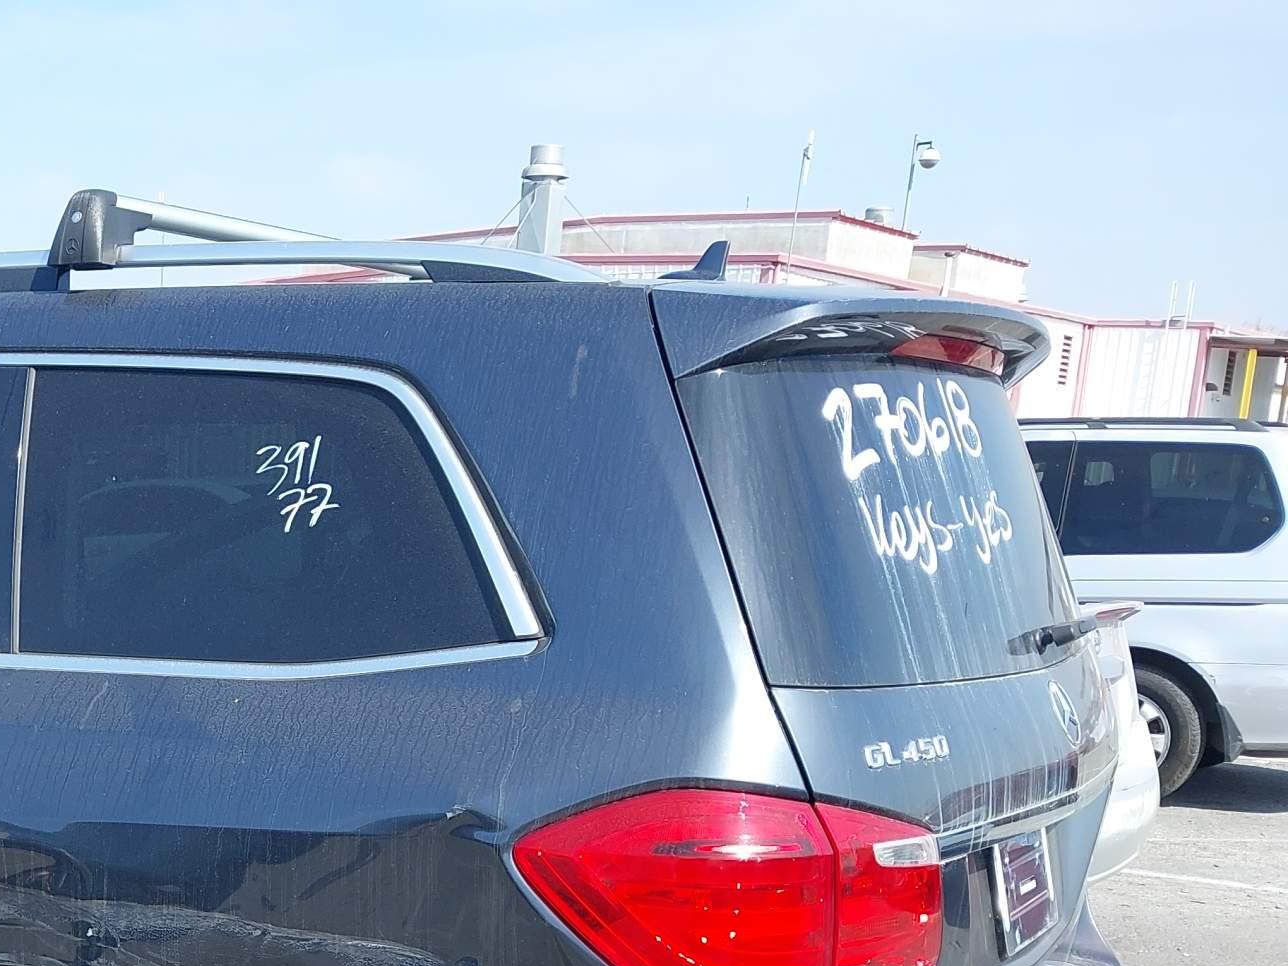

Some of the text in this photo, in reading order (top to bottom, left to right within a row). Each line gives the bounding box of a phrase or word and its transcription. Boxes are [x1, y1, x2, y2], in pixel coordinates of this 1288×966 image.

[255, 435, 322, 496] 391
[277, 483, 340, 533] 77
[864, 735, 950, 769] GL 450
